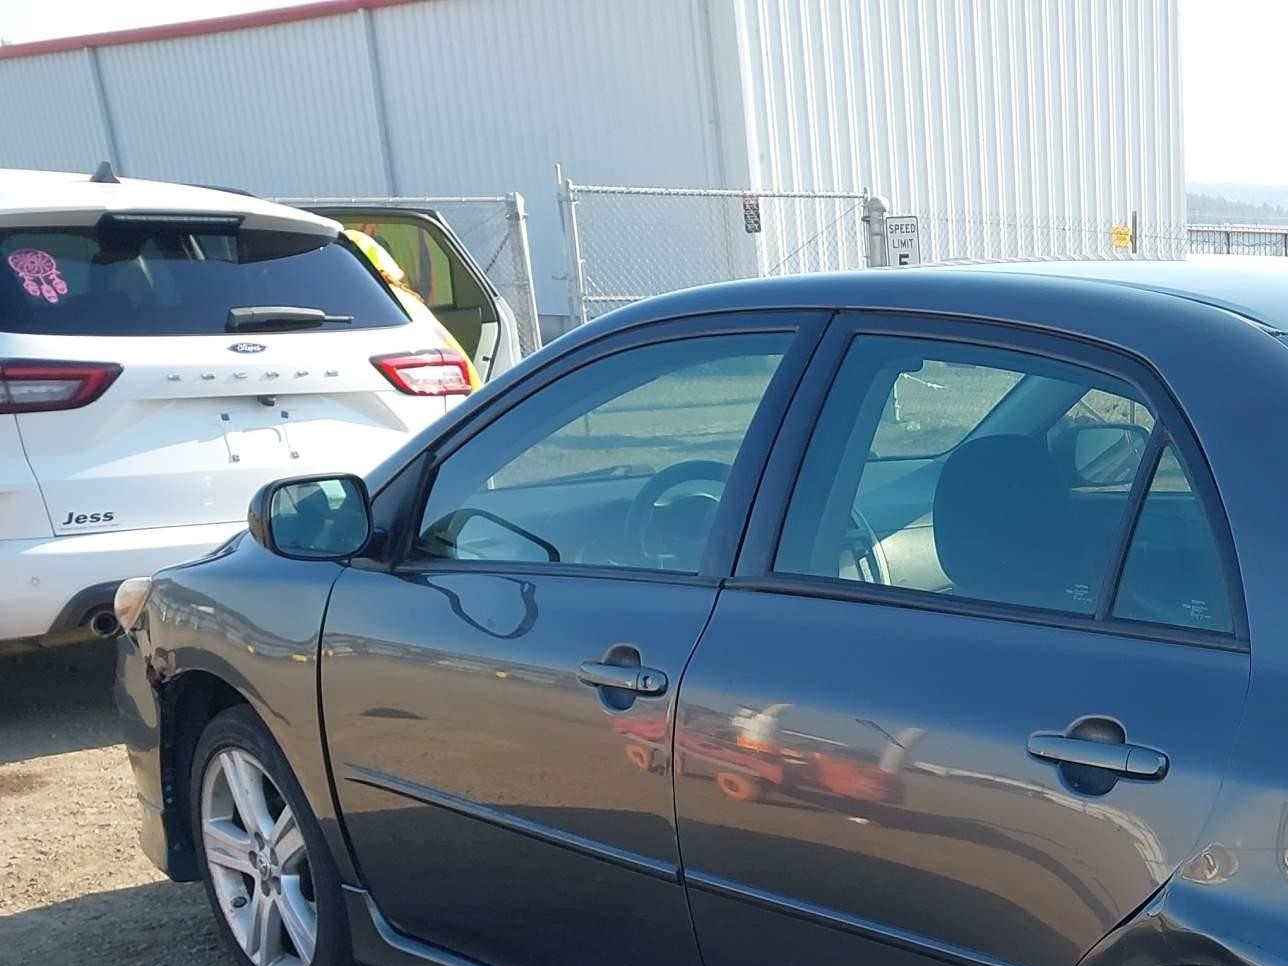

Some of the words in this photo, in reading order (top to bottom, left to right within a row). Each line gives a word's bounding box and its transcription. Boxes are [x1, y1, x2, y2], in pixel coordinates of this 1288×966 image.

[889, 223, 916, 234] SPEED
[892, 238, 914, 249] LIMIT
[62, 511, 114, 526] Jess
